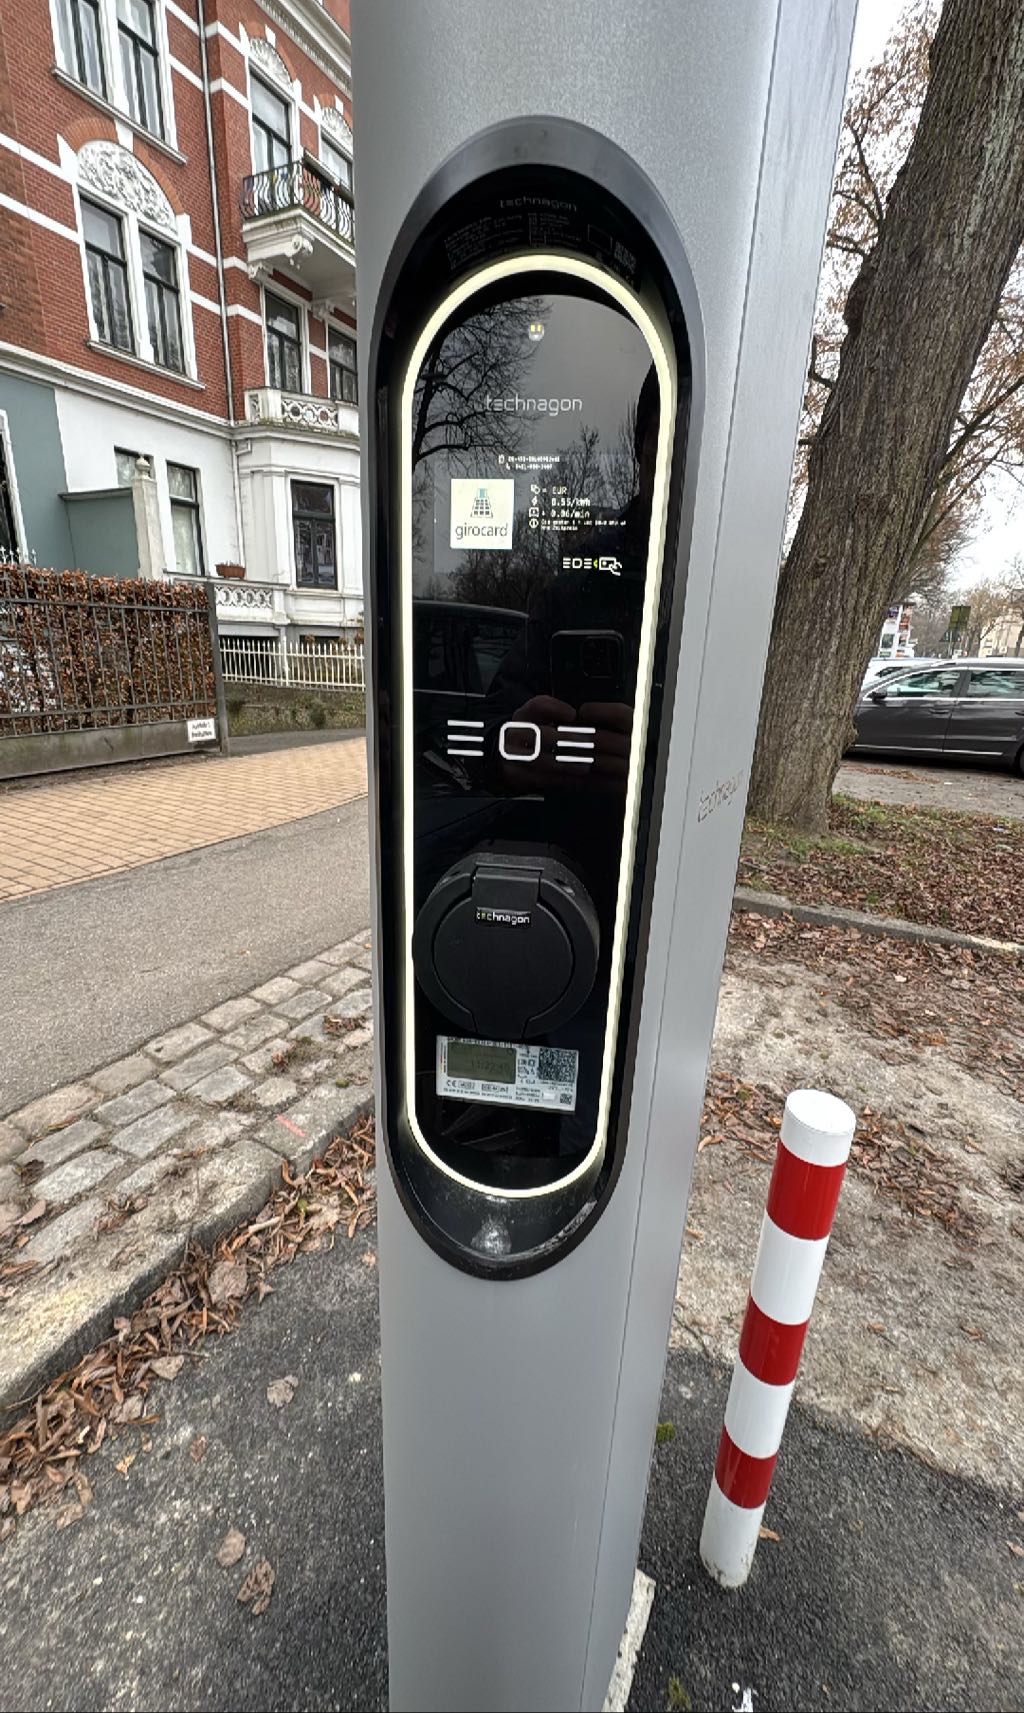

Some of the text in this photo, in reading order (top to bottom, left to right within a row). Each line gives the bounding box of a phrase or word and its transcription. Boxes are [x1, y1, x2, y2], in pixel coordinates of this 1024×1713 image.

[500, 196, 577, 212] technagon
[486, 394, 583, 416] technagon
[455, 523, 508, 540] girocard
[476, 911, 530, 926] technagon
